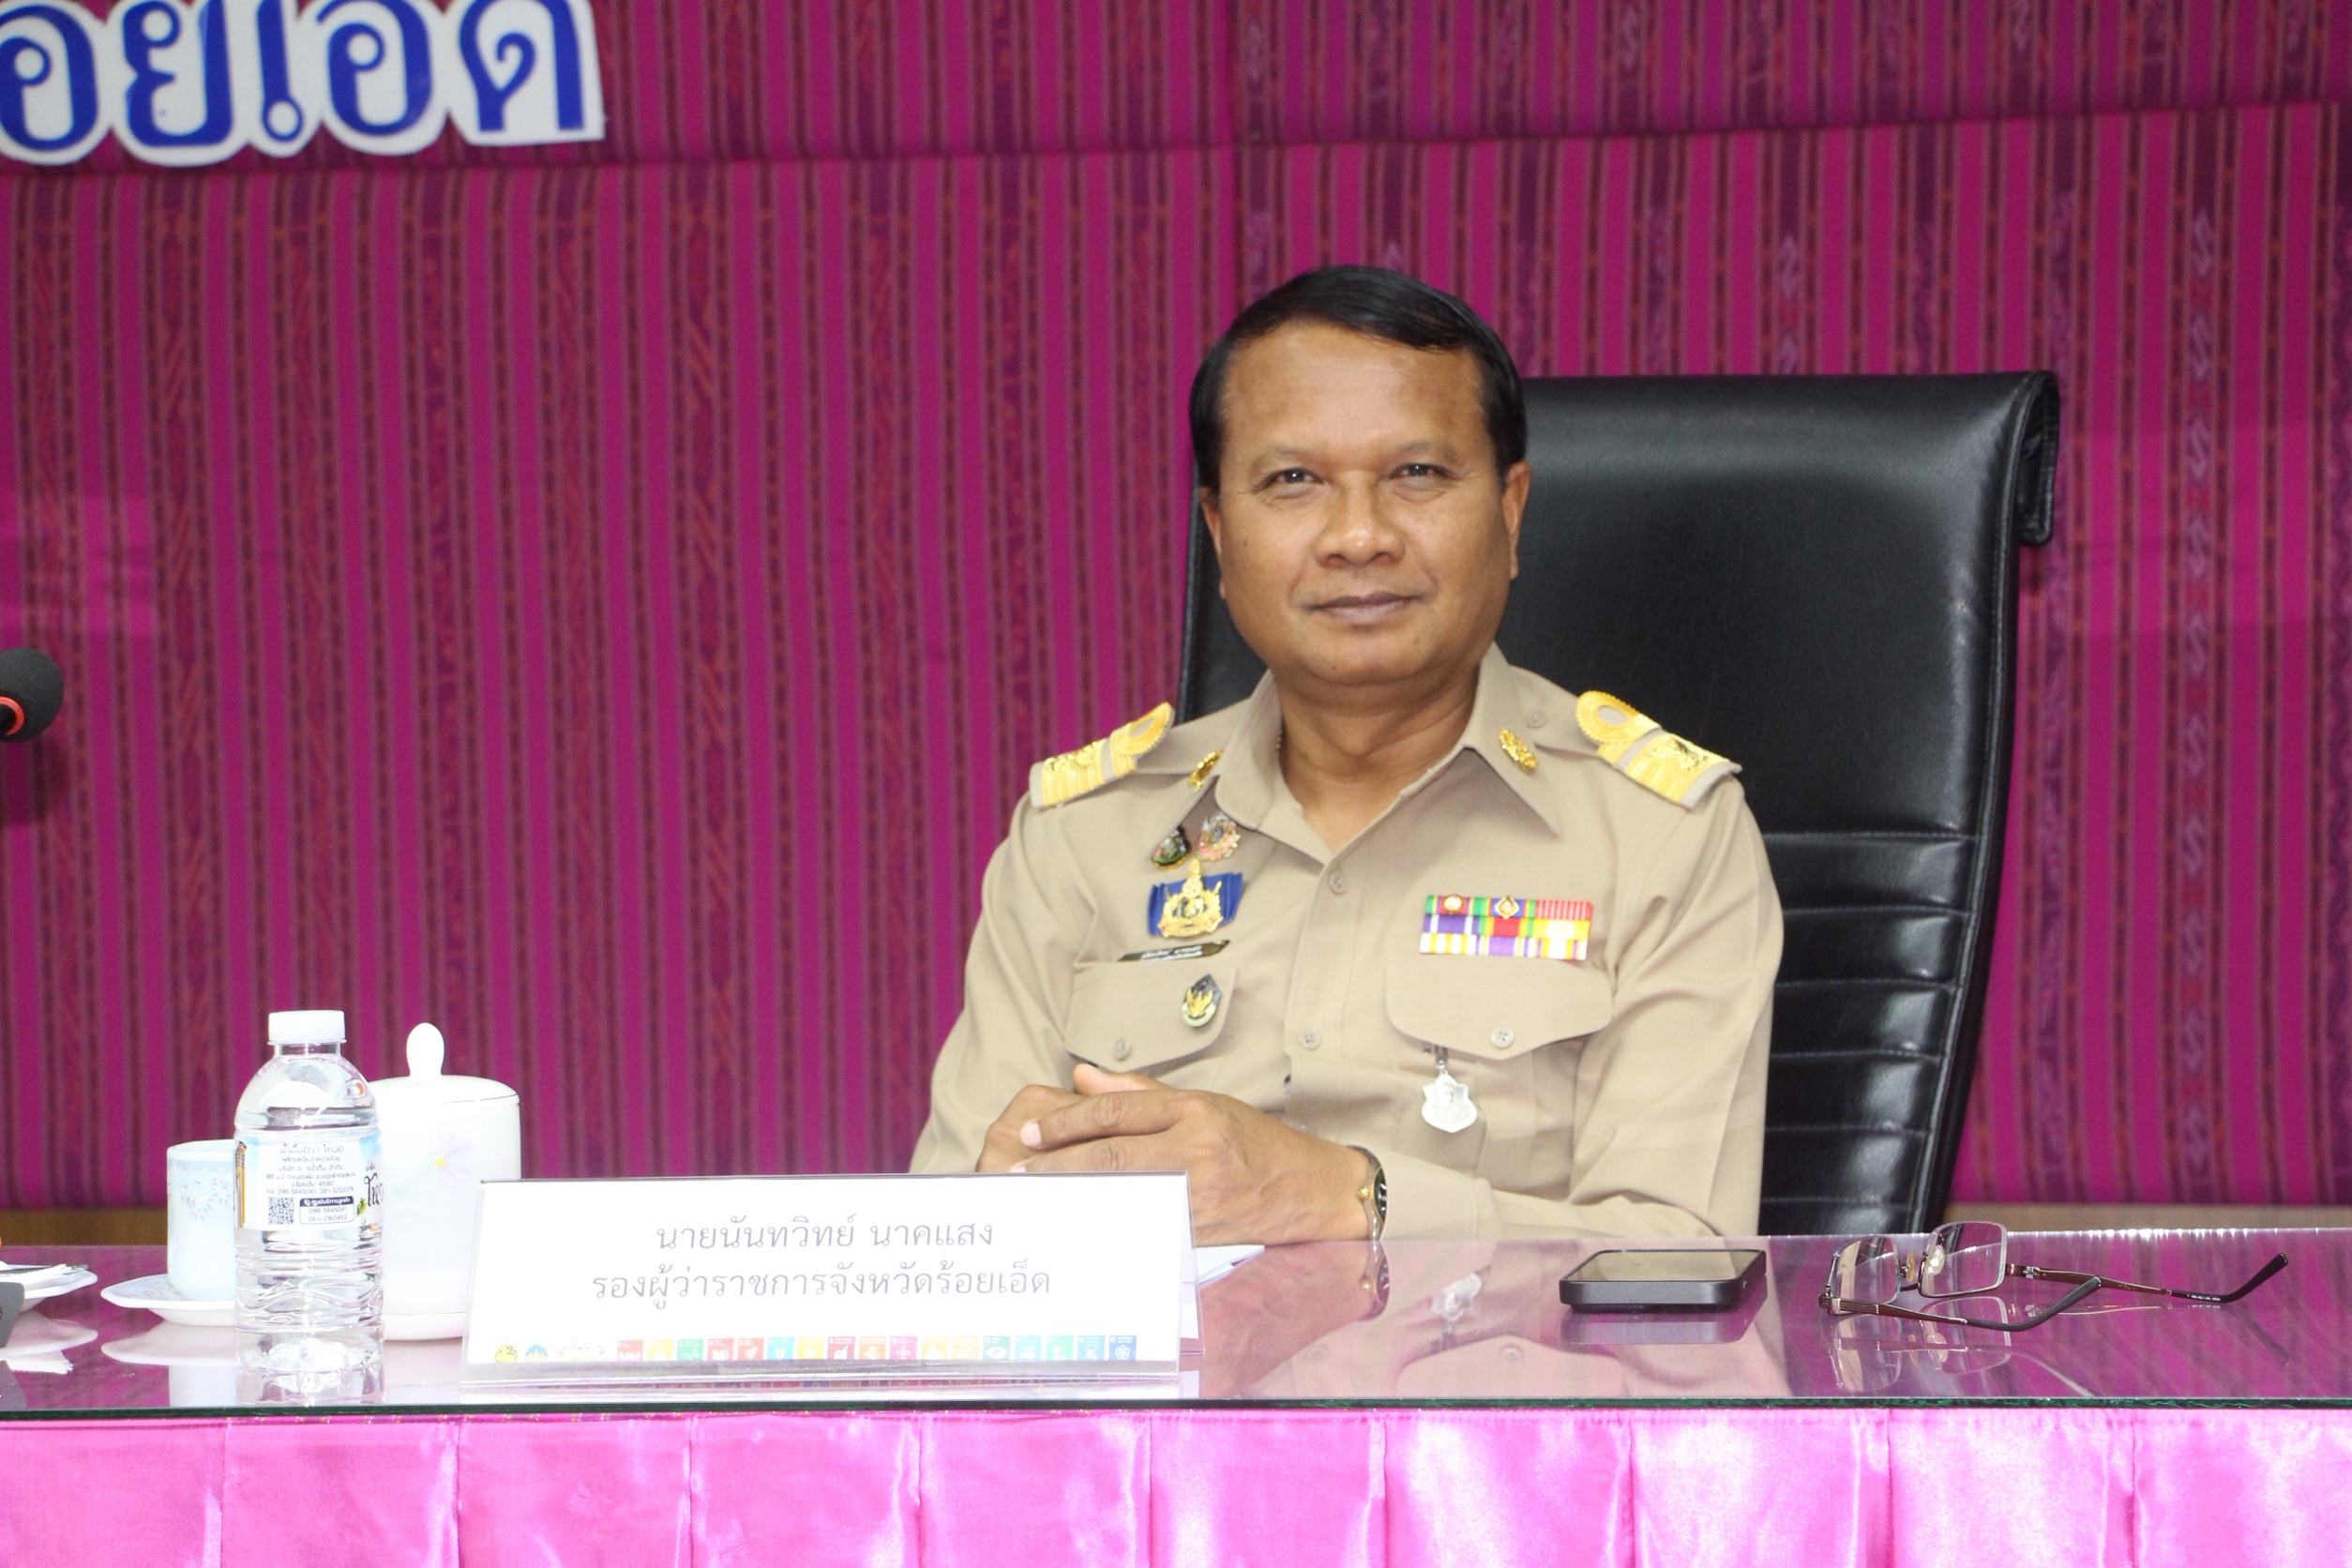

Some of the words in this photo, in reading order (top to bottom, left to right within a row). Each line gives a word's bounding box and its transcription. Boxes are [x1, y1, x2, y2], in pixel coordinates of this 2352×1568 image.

[656, 1213, 857, 1249] นายนันทวิทย์
[869, 1222, 994, 1247] นาคแสง
[592, 1258, 1051, 1310] รองผู้ว่าราชการจังหวัดร้อยเอ็ด
